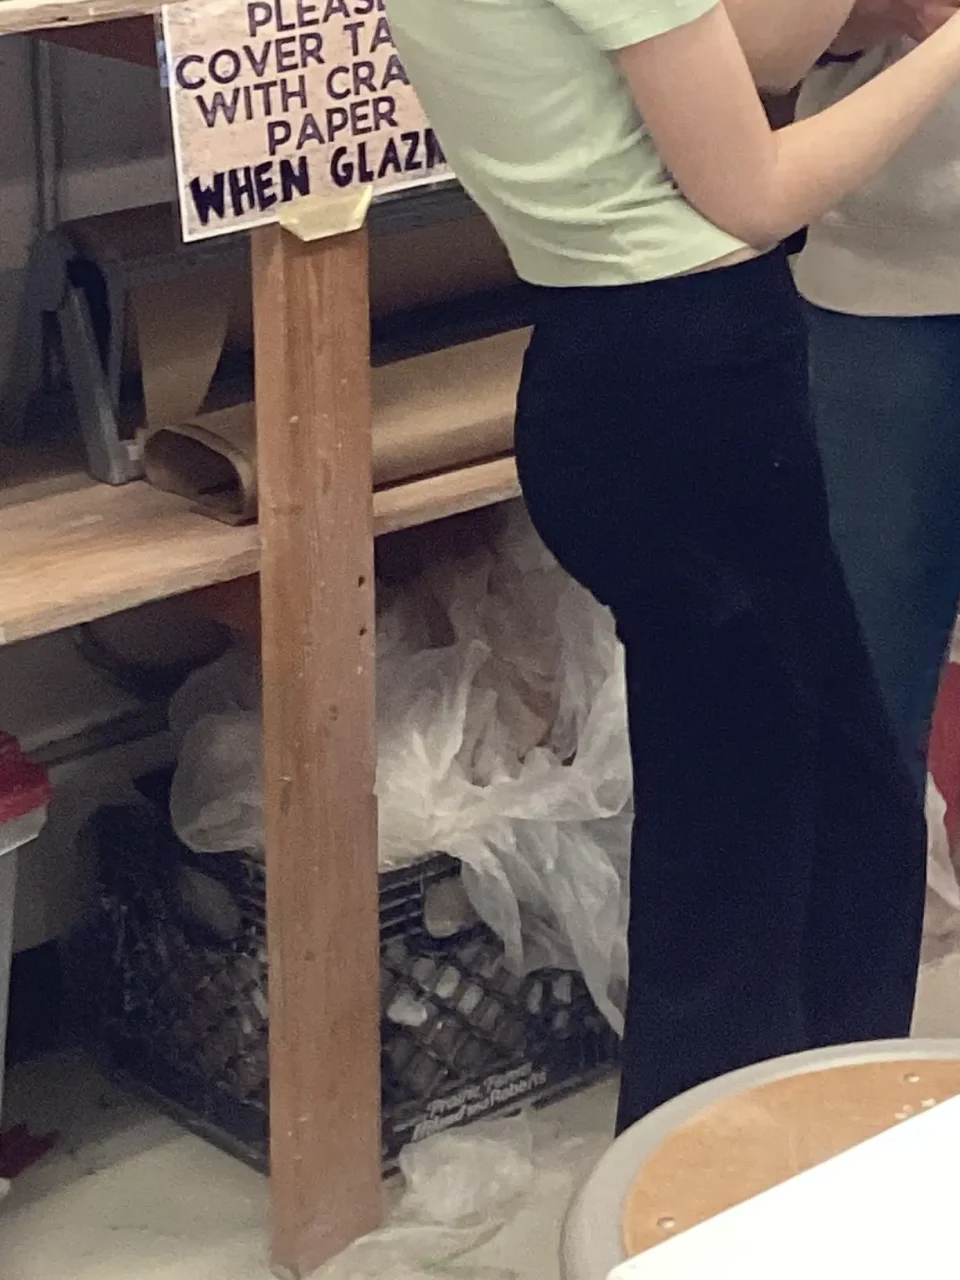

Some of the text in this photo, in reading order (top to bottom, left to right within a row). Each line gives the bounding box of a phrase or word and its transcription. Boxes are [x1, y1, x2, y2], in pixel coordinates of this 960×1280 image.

[175, 31, 325, 90] COVER
[195, 75, 307, 128] WITH
[267, 96, 398, 156] PAPER
[189, 155, 310, 226] WHEN
